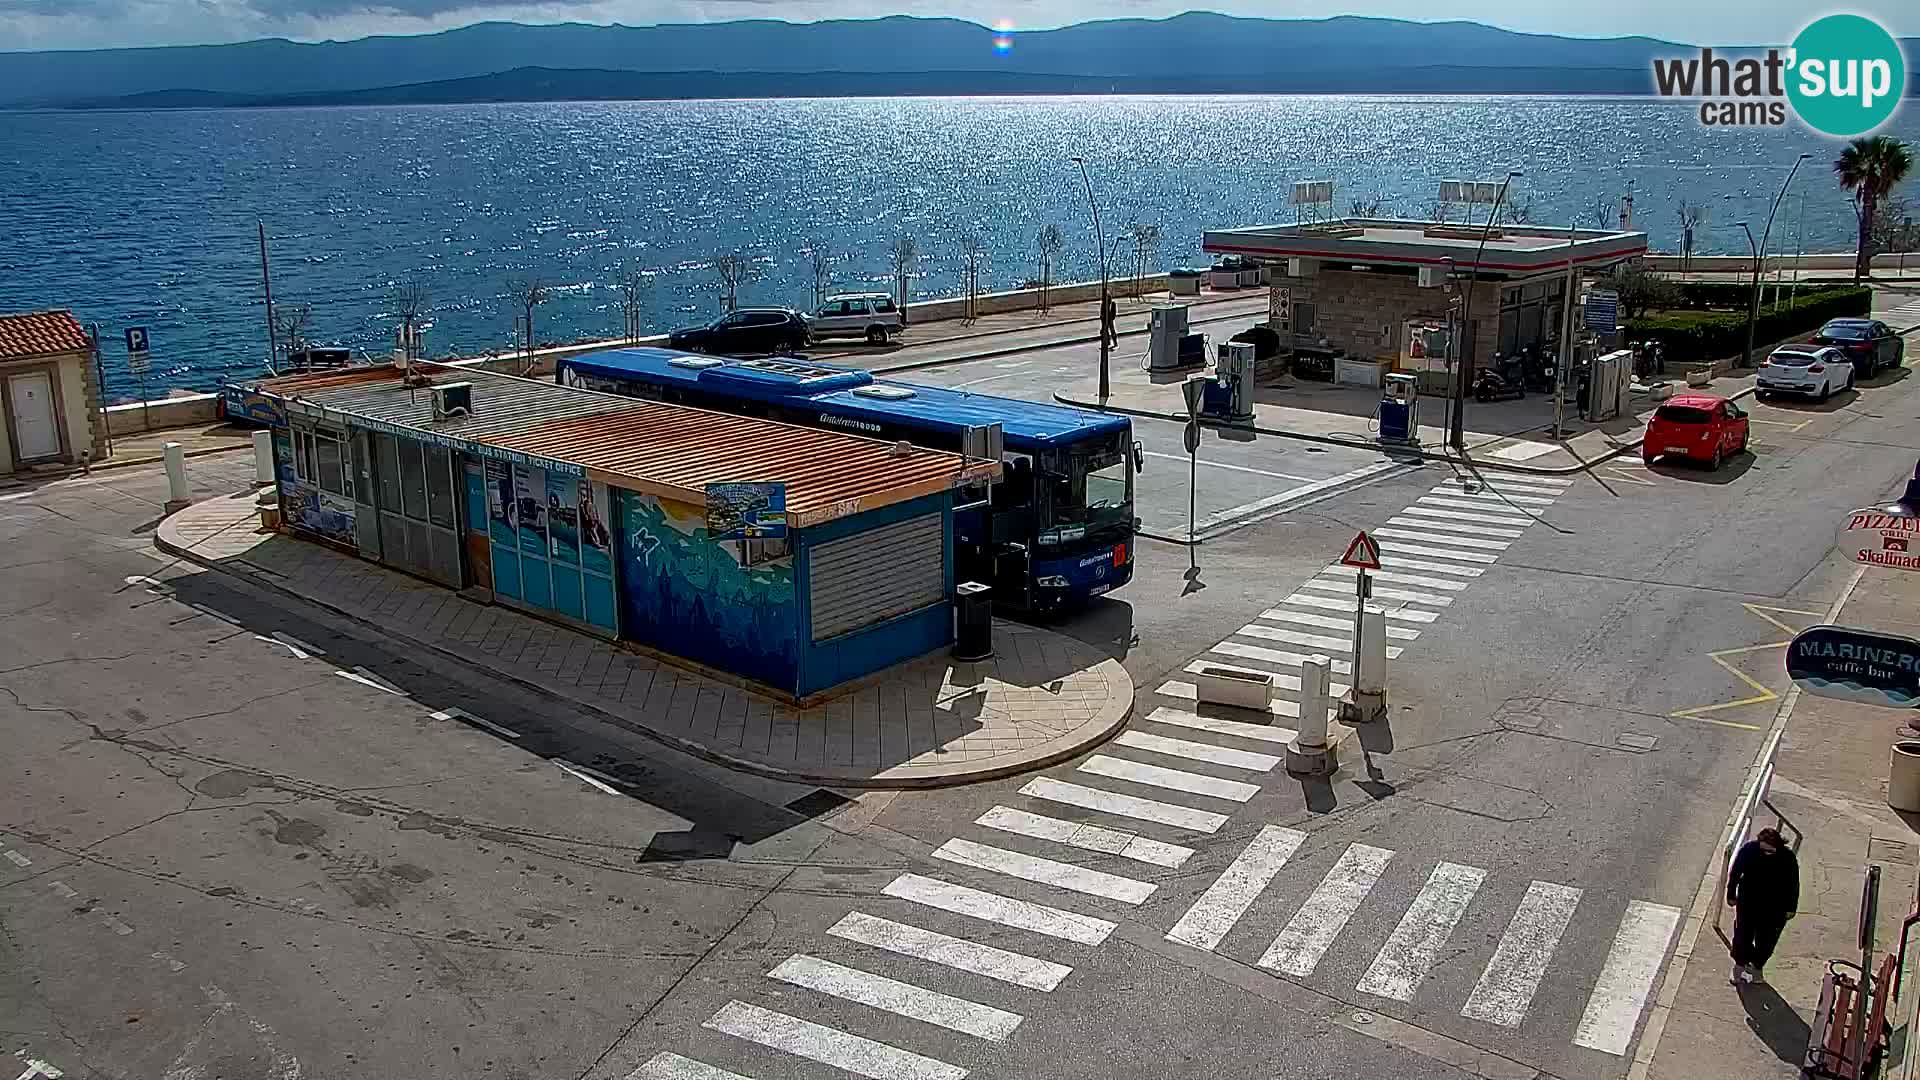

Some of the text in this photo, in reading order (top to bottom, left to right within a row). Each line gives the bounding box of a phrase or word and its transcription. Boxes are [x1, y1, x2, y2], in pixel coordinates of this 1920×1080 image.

[130, 331, 143, 349] P
[478, 445, 493, 457] BUS
[494, 449, 527, 465] STATION
[528, 456, 554, 471] TICKET
[555, 463, 583, 477] OFFICE
[1868, 664, 1895, 681] bar
